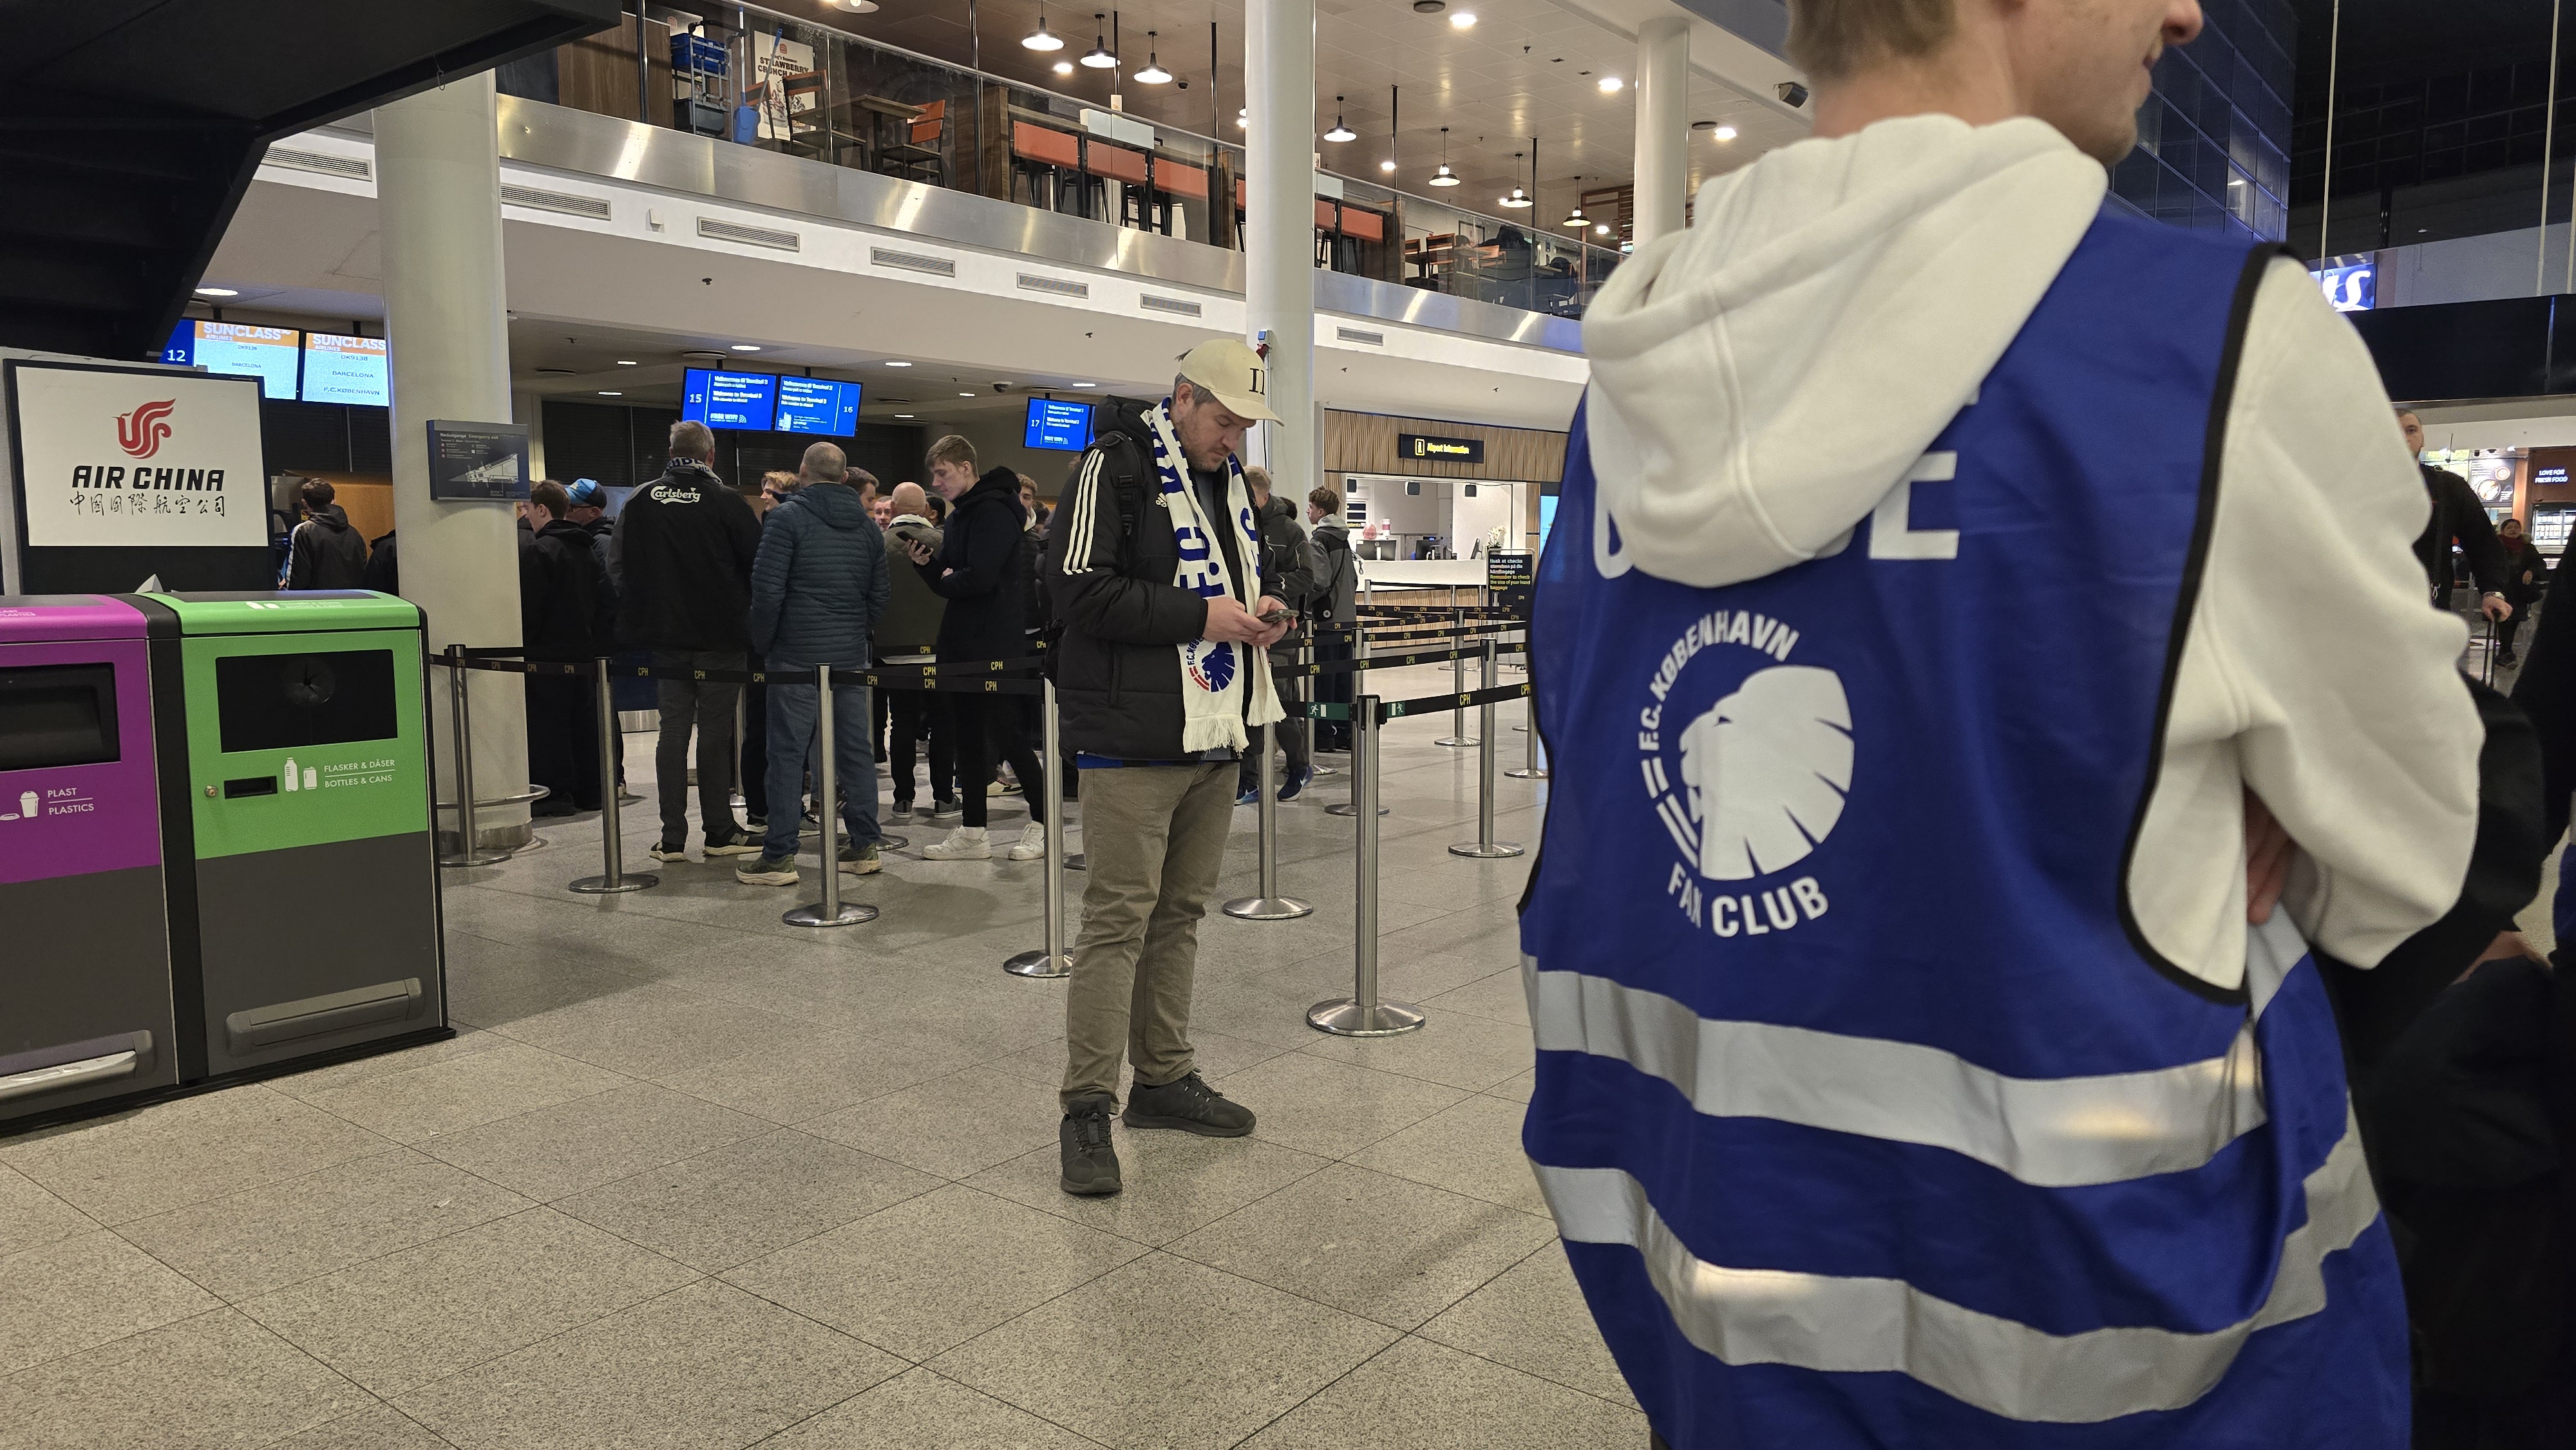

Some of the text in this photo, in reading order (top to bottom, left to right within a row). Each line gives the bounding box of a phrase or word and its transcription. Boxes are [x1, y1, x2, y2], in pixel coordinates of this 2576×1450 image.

[203, 323, 281, 341] SUNCLASS
[312, 335, 386, 351] SUNCLASS
[167, 350, 186, 362] 12
[689, 393, 703, 403] 15
[1031, 419, 1040, 428] 17
[72, 465, 225, 491] AIR CHINA
[650, 485, 701, 505] Carlsberg
[920, 646, 931, 654] CPH
[1449, 650, 1458, 659] CPH
[457, 658, 466, 667] CPH
[1359, 659, 1369, 670] CPH
[1406, 655, 1416, 664] CPH
[491, 661, 500, 670] CPH
[527, 663, 536, 672] CPH
[564, 664, 574, 674] CPH
[923, 666, 936, 676] CPH
[990, 661, 1003, 671] CPH
[1310, 664, 1320, 674] CPH
[638, 666, 649, 677] CPH
[694, 670, 706, 680] CPH
[753, 672, 765, 683] CPH
[867, 675, 878, 686] CPH
[1638, 609, 1801, 751] F.C. KØBENHAVN
[924, 678, 936, 690] CPH
[985, 681, 998, 692] CPH
[1459, 693, 1471, 706] CPH
[324, 762, 359, 773] FLASKER
[370, 758, 395, 768] DÅSER
[325, 778, 359, 787] BOTTLES
[368, 775, 393, 784] CANS
[48, 787, 77, 798] PLAST
[48, 803, 95, 815] PLASTICS
[1667, 860, 1829, 938] FAN CLUB
